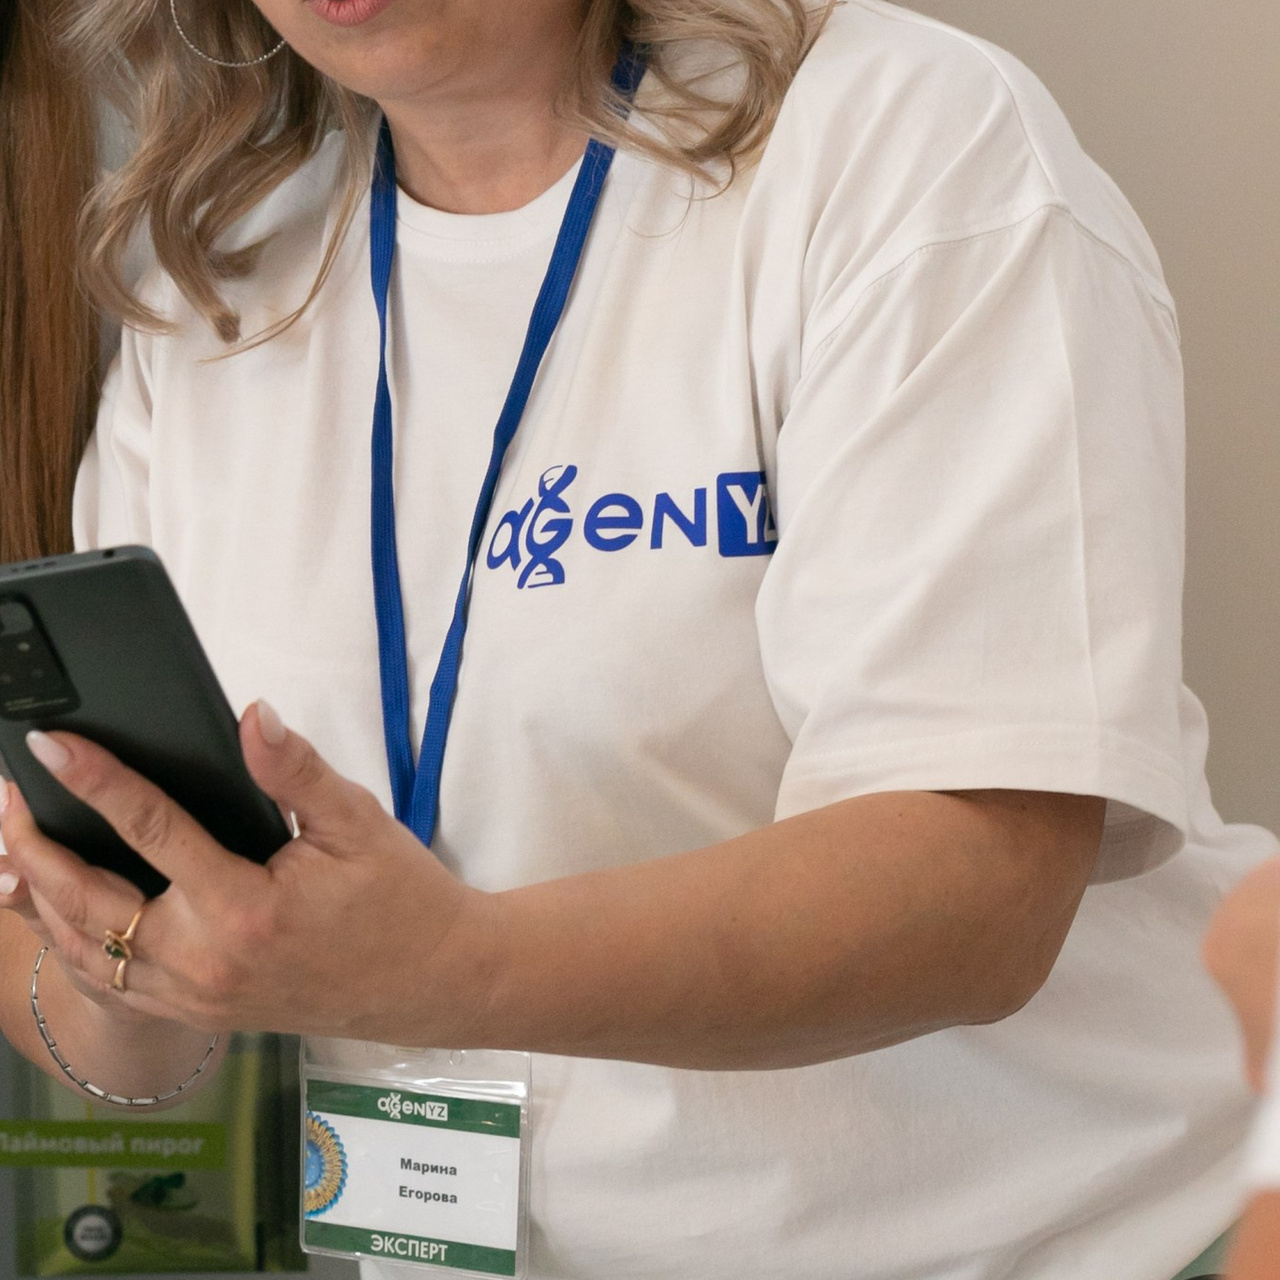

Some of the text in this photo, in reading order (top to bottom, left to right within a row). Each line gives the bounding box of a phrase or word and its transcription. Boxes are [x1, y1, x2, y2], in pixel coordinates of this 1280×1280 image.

[400, 1158, 457, 1176] Марина
[399, 1186, 458, 1204] Егорова
[370, 1234, 449, 1261] ЭКСПЕРТ
